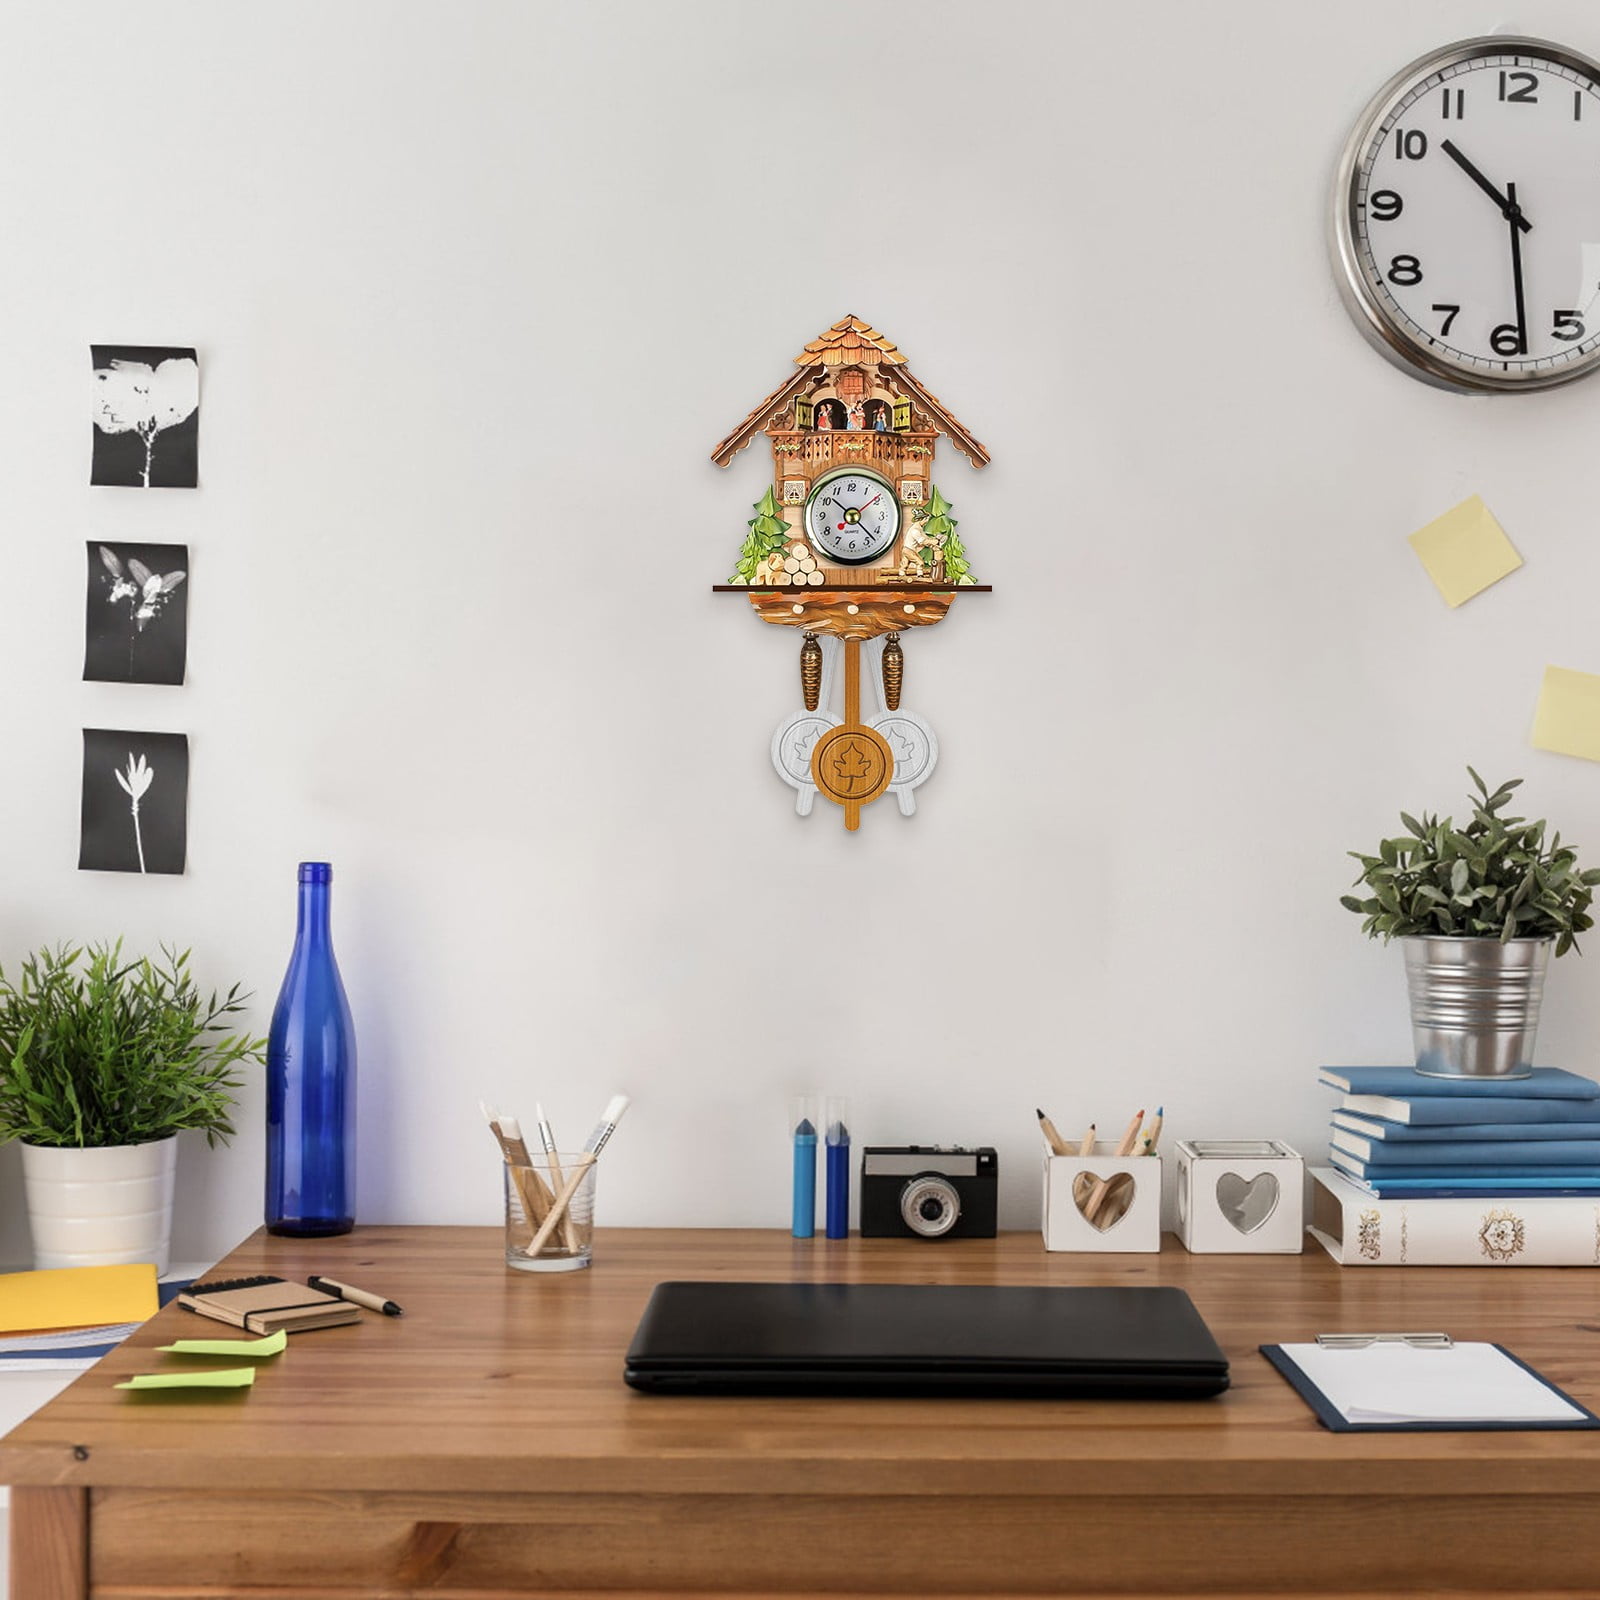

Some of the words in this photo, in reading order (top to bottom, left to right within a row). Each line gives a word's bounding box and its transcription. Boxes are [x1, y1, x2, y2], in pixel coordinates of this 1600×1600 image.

[1499, 71, 1538, 103] 12
[1442, 88, 1464, 120] 11
[1395, 128, 1428, 160] 10
[1370, 190, 1403, 221] 9
[1387, 254, 1423, 286] 8
[1432, 304, 1460, 336] 7
[1550, 310, 1586, 342] 5
[1490, 324, 1523, 357] 6
[833, 487, 841, 495] 11
[847, 483, 856, 492] 12
[864, 487, 868, 495] 1
[822, 497, 831, 505] 10
[873, 497, 880, 505] 2
[819, 512, 826, 520] 9
[879, 511, 885, 520] 3
[823, 526, 830, 535] 8
[874, 526, 880, 534] 4
[835, 536, 841, 545] 7
[849, 540, 855, 549] 6
[863, 537, 870, 545] 5
